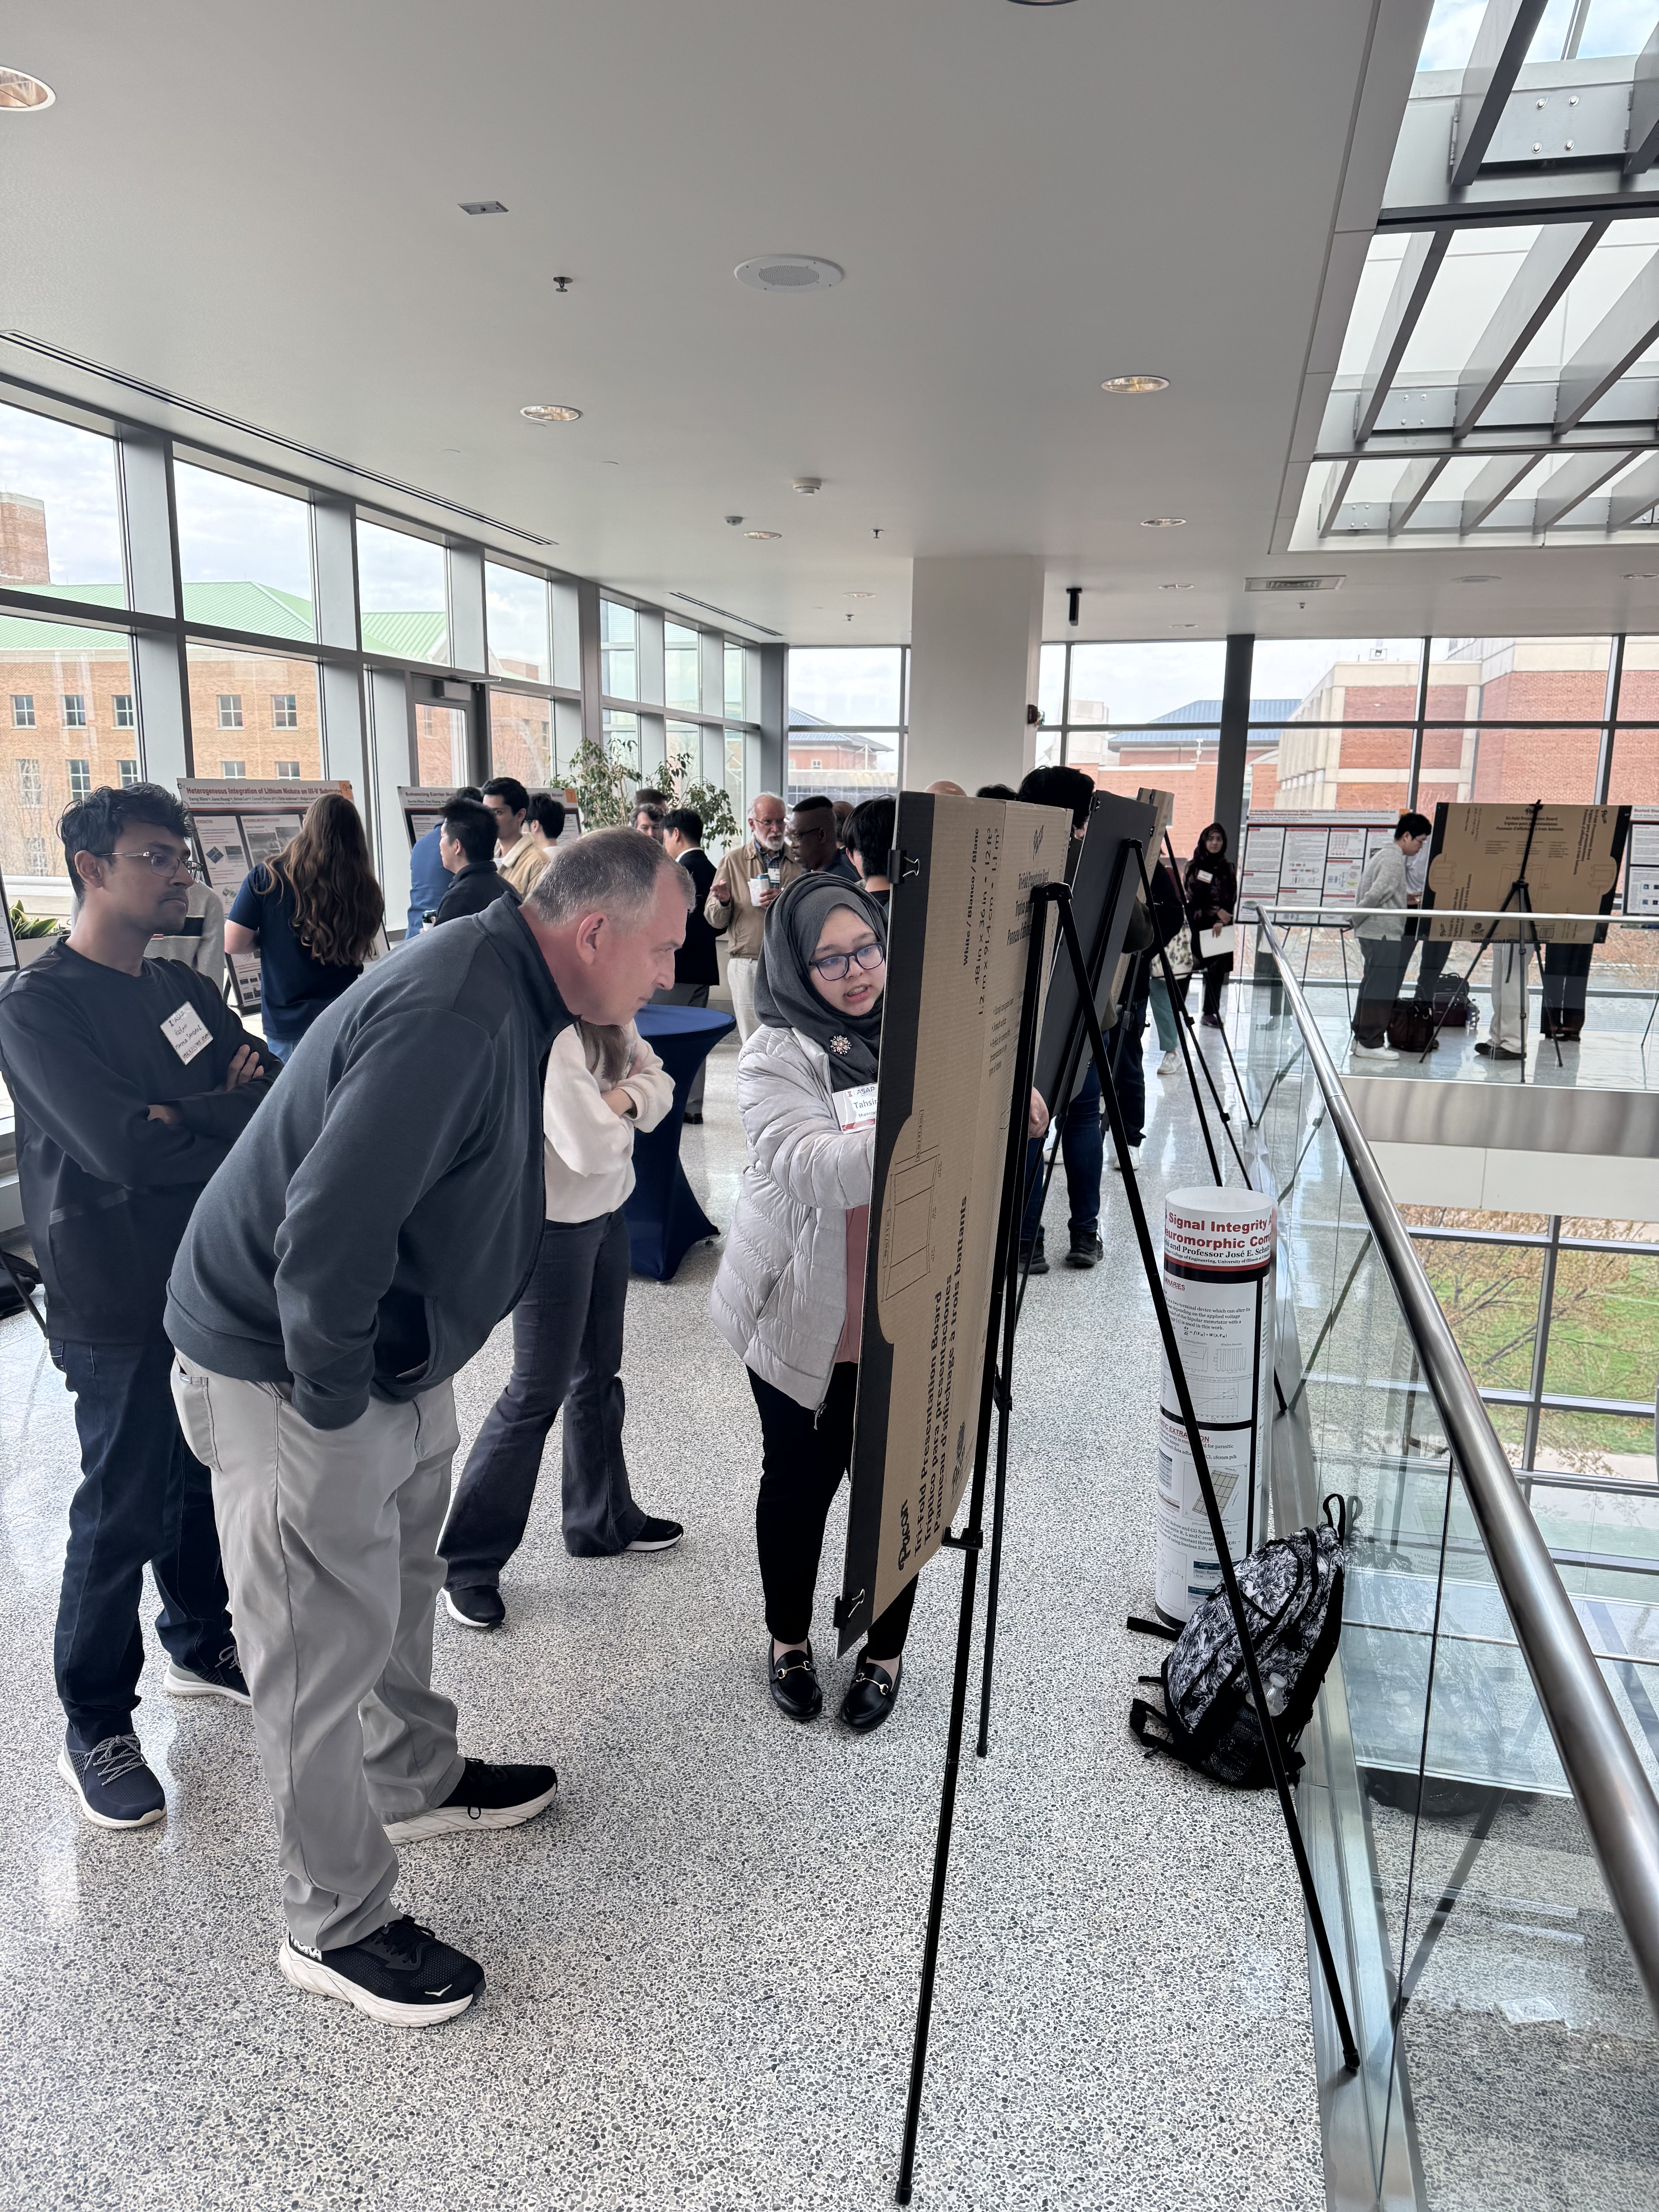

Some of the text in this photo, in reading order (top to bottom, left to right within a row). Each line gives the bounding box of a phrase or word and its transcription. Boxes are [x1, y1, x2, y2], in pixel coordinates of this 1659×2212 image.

[982, 891, 987, 905] in
[979, 908, 985, 928] 36
[977, 948, 982, 962] in
[975, 965, 981, 985] 48
[857, 1086, 875, 1095] ASAP
[1169, 1212, 1267, 1234] Signal Integrity
[954, 1196, 967, 1278] battants
[1165, 1228, 1245, 1251] euromorphic
[1170, 1243, 1181, 1252] and
[1182, 1246, 1224, 1258] Professor
[1189, 1256, 1217, 1264] Engineering,
[951, 1280, 960, 1326] trois
[924, 1274, 953, 1546] Triptico para presentaciones
[914, 1290, 942, 1557] Tri-Fold Presentation Board
[934, 1453, 946, 1534] Panneau
[898, 1499, 911, 1571] Pacon
[291, 1936, 322, 1961] OKA
